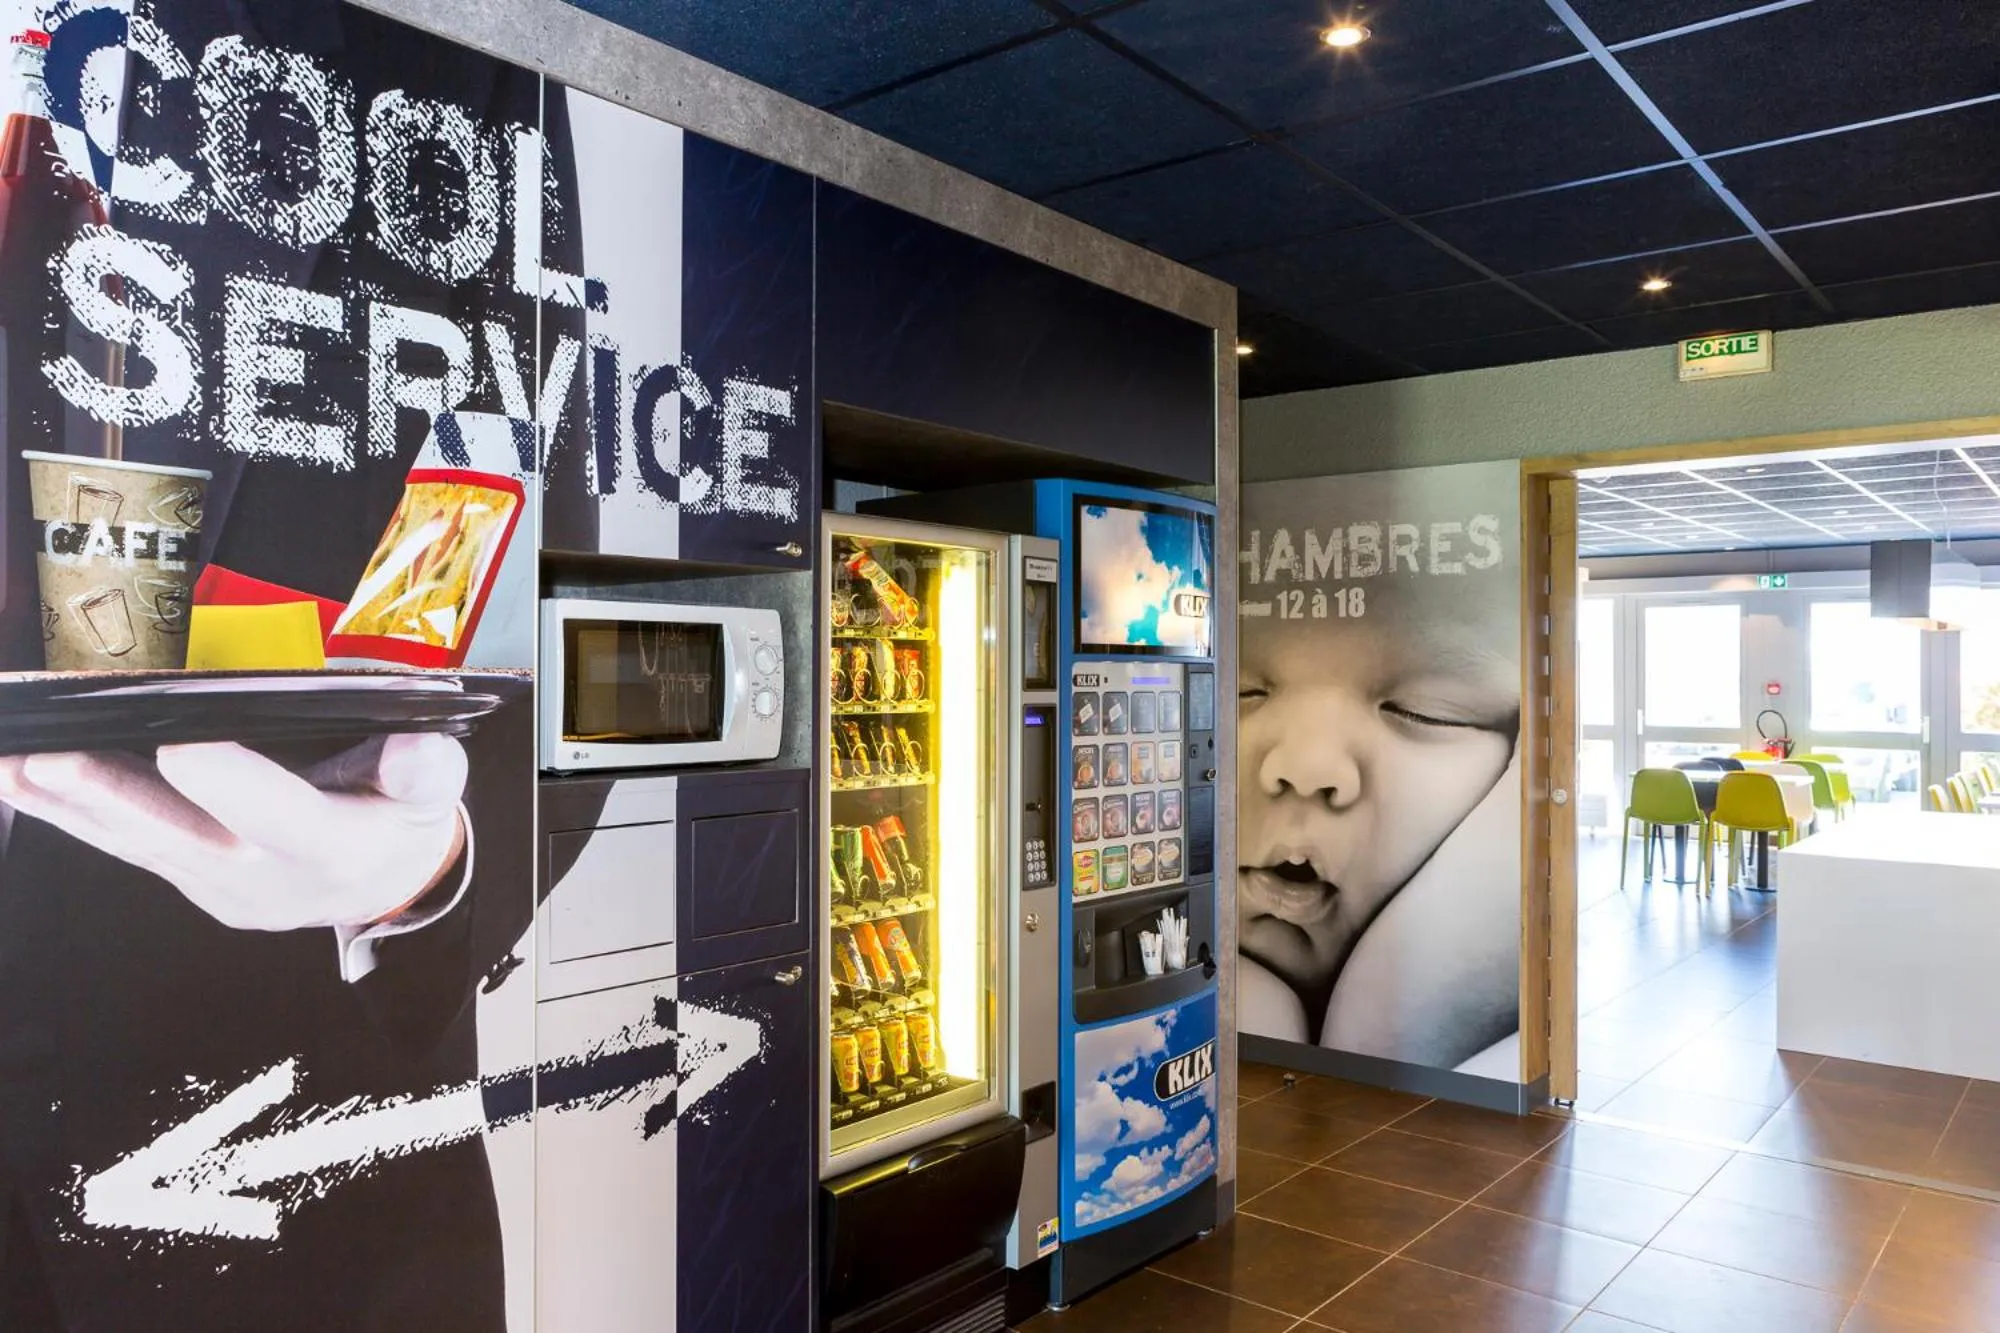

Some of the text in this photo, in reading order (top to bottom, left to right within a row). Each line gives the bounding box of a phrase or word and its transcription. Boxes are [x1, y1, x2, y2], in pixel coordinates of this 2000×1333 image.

[42, 1, 608, 313] COOL
[1687, 334, 1758, 359] SORTIE
[42, 223, 800, 524] SERVICE
[44, 517, 186, 572] CAFE
[1276, 587, 1366, 619] 12 à 18
[1076, 674, 1098, 687] KLIX
[1169, 1044, 1212, 1095] KLIX
